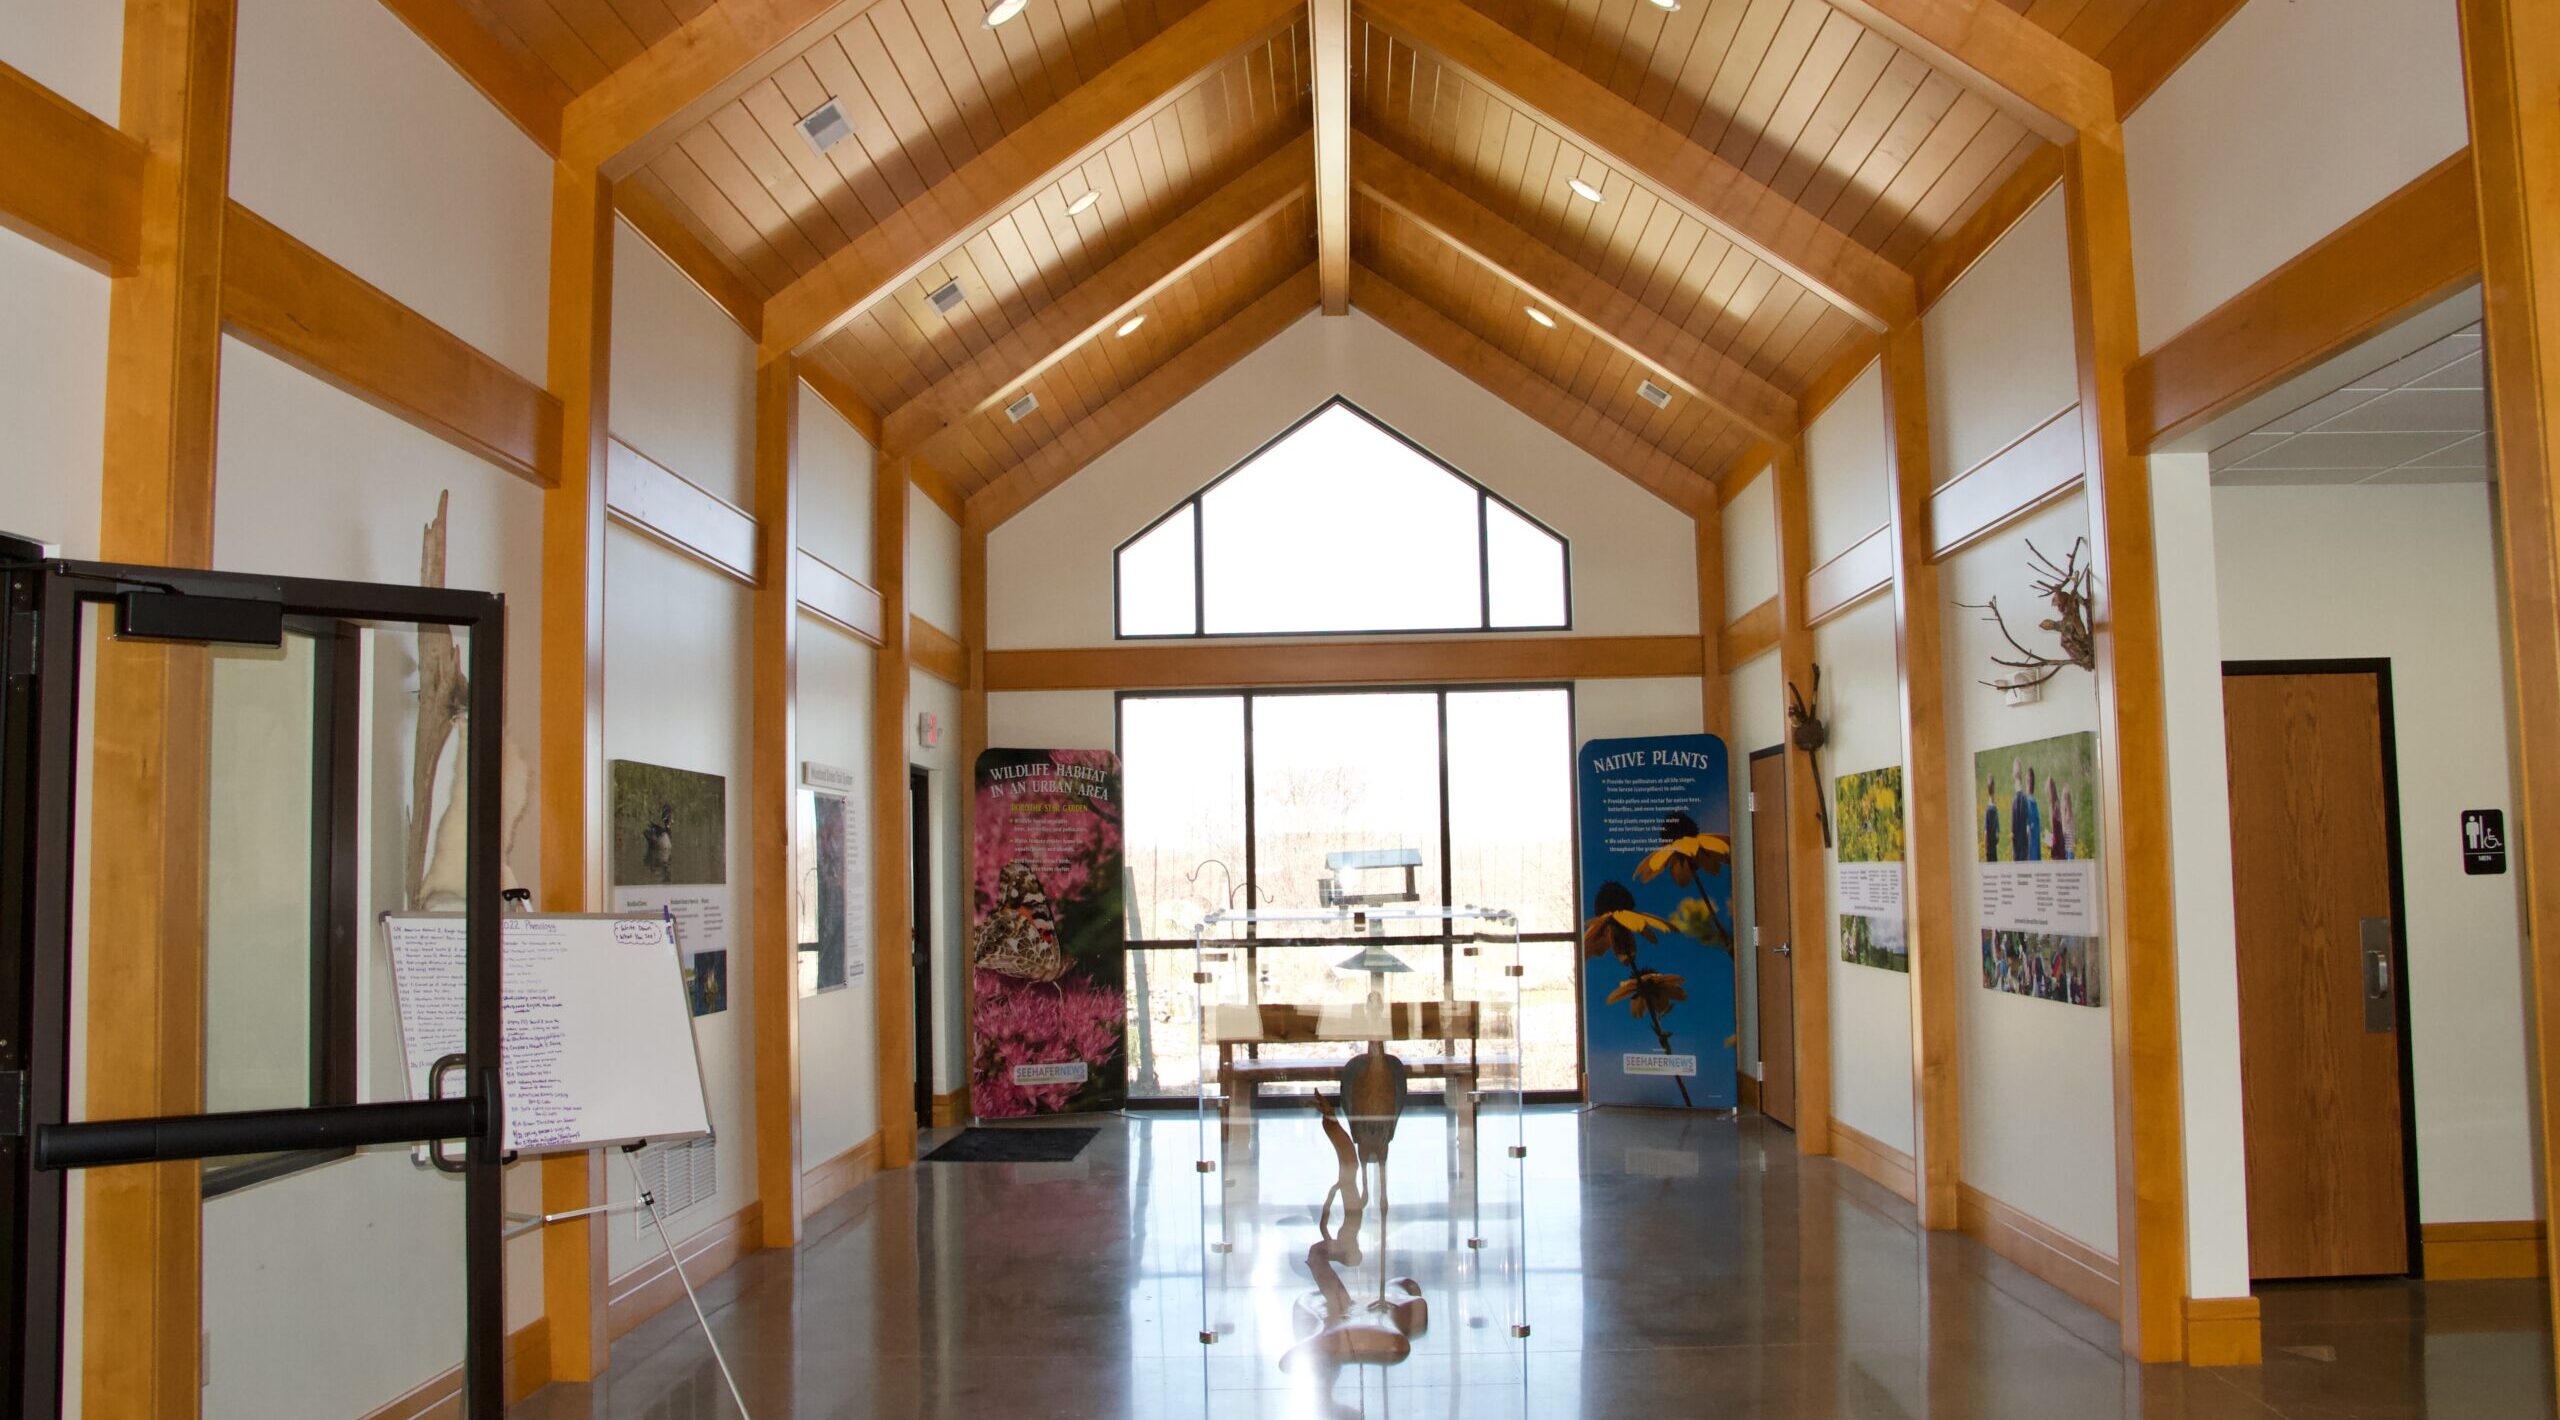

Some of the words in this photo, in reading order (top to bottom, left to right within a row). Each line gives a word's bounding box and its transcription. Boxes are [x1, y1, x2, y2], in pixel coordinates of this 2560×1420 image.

[1593, 751, 1646, 774] NATIVE
[1652, 750, 1709, 770] PLANTS
[989, 763, 1050, 780] WILDLIFE
[1055, 763, 1108, 783] HABITAT
[989, 784, 1004, 798] IN
[1010, 781, 1026, 794] AN
[1032, 780, 1073, 793] URBAN
[1078, 785, 1109, 800] AREA
[1062, 803, 1088, 812] GARDEN
[1626, 1055, 1694, 1068] SEEHAFERNEWS
[1016, 1065, 1085, 1078] SEEHAFERNEWS
